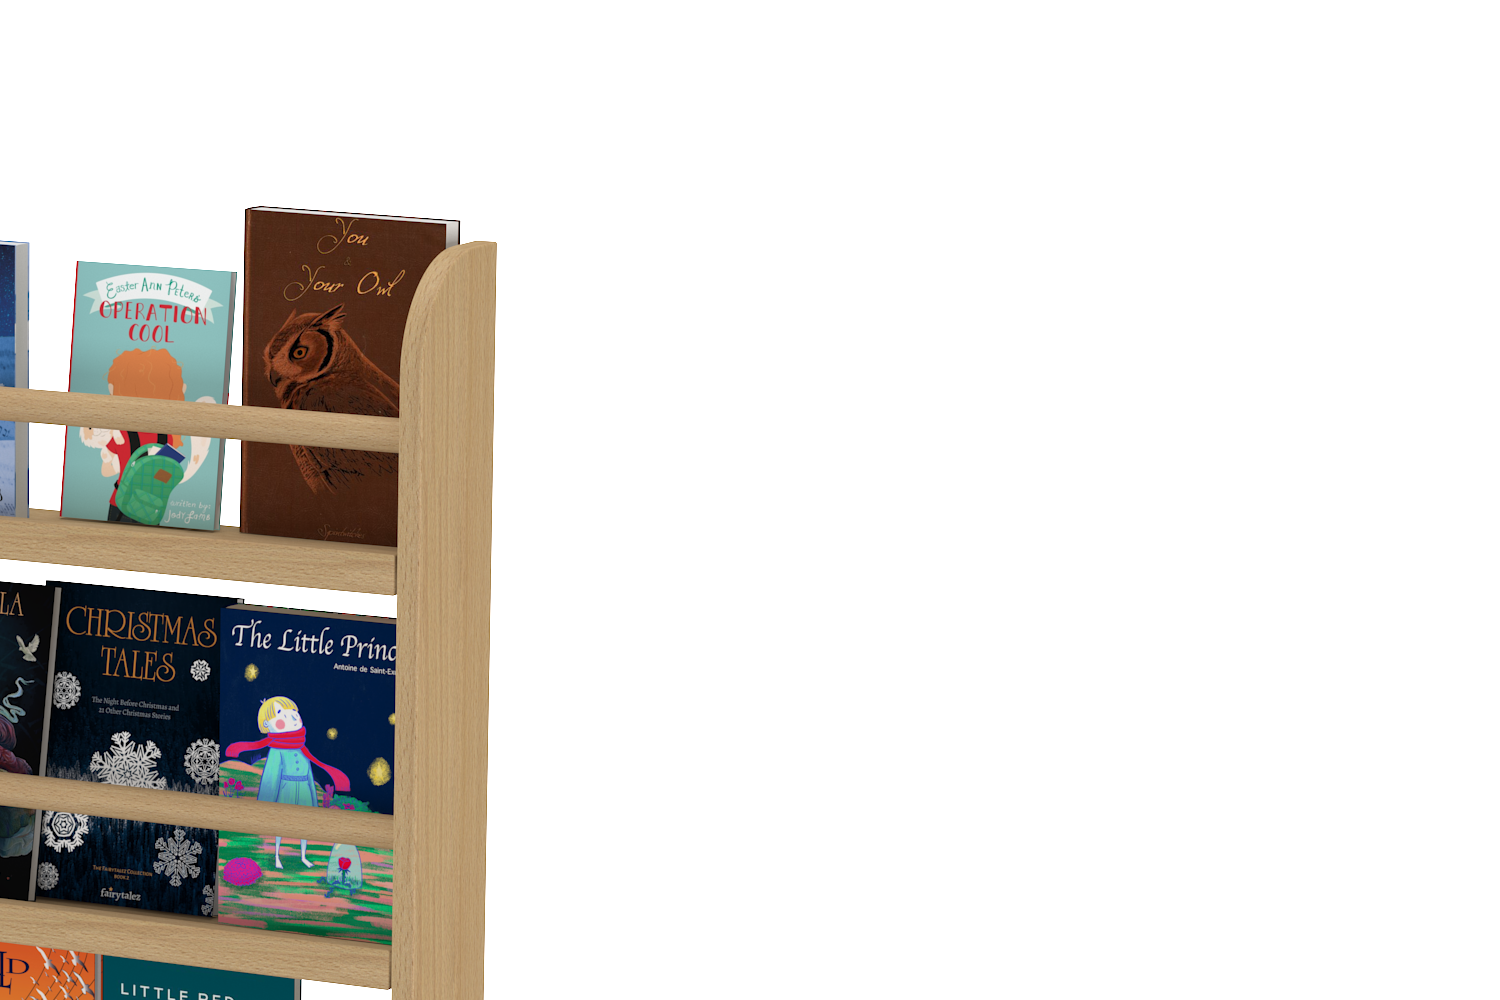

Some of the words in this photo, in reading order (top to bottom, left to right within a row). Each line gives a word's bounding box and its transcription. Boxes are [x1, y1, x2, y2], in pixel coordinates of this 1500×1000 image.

[317, 217, 369, 255] You
[106, 281, 139, 300] Easter
[284, 265, 344, 302] Your
[357, 270, 406, 297] Owl
[100, 300, 207, 326] OPERATION
[129, 323, 175, 344] COOL
[66, 605, 218, 649] CHRISTMAS
[232, 619, 272, 649] The
[277, 627, 334, 656] Little
[340, 635, 397, 662] Princ
[101, 645, 176, 683] TALES
[333, 663, 358, 672] Antoine
[92, 696, 103, 704] The
[103, 698, 119, 707] Night
[120, 699, 138, 708] Before
[139, 701, 168, 711] Christmas
[168, 704, 180, 712] and
[105, 707, 122, 715] Other
[122, 709, 152, 719] Christmas
[152, 712, 172, 721] Stories
[100, 887, 141, 902] fairytalez
